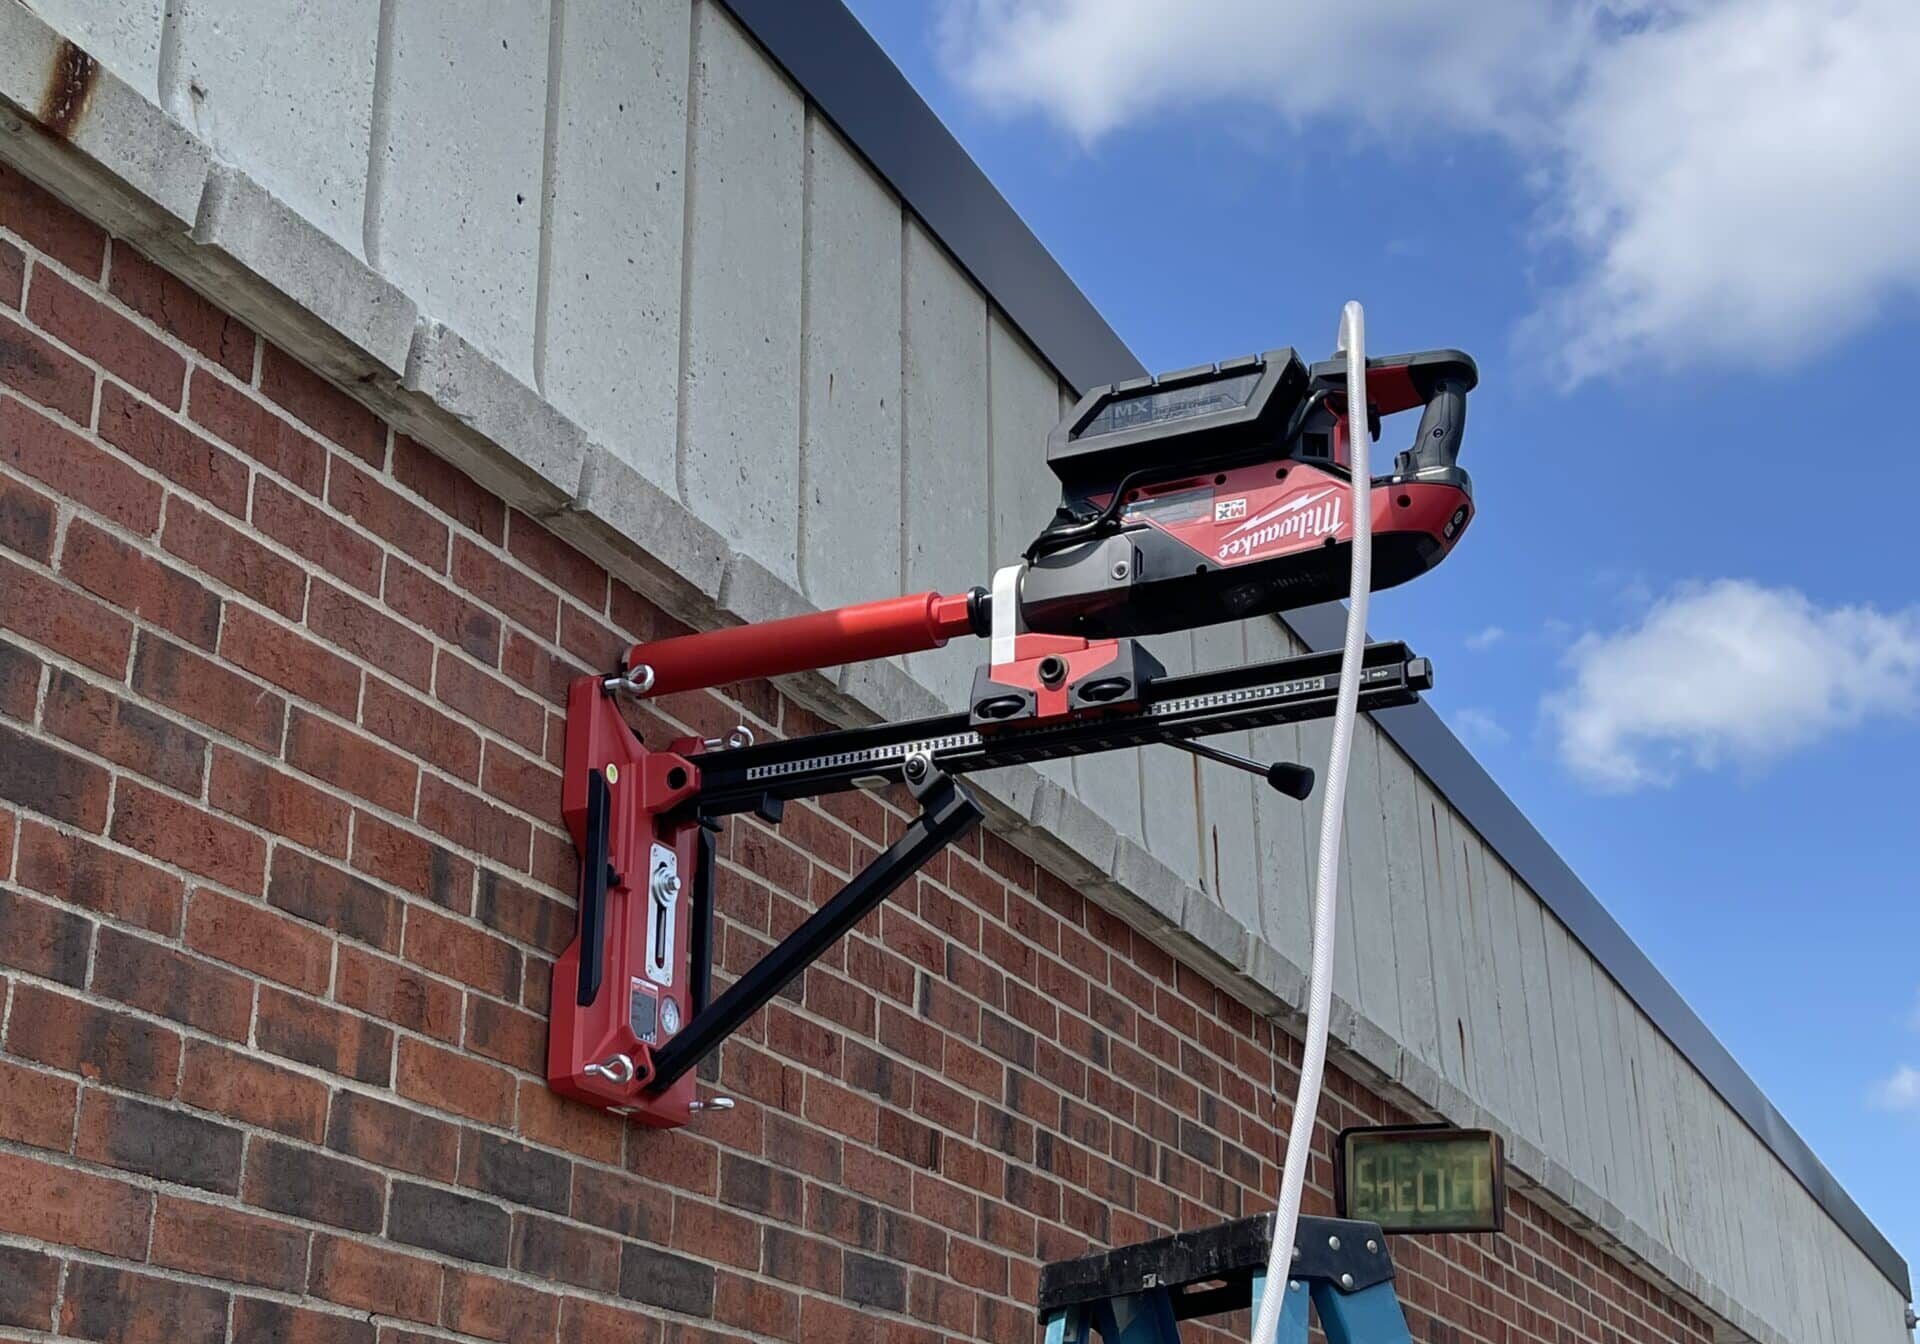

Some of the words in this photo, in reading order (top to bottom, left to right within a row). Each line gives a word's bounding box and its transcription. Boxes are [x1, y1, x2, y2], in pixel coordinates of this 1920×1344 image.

[1114, 400, 1149, 418] MX
[1217, 506, 1245, 519] MX
[1218, 496, 1344, 558] Milwaukee
